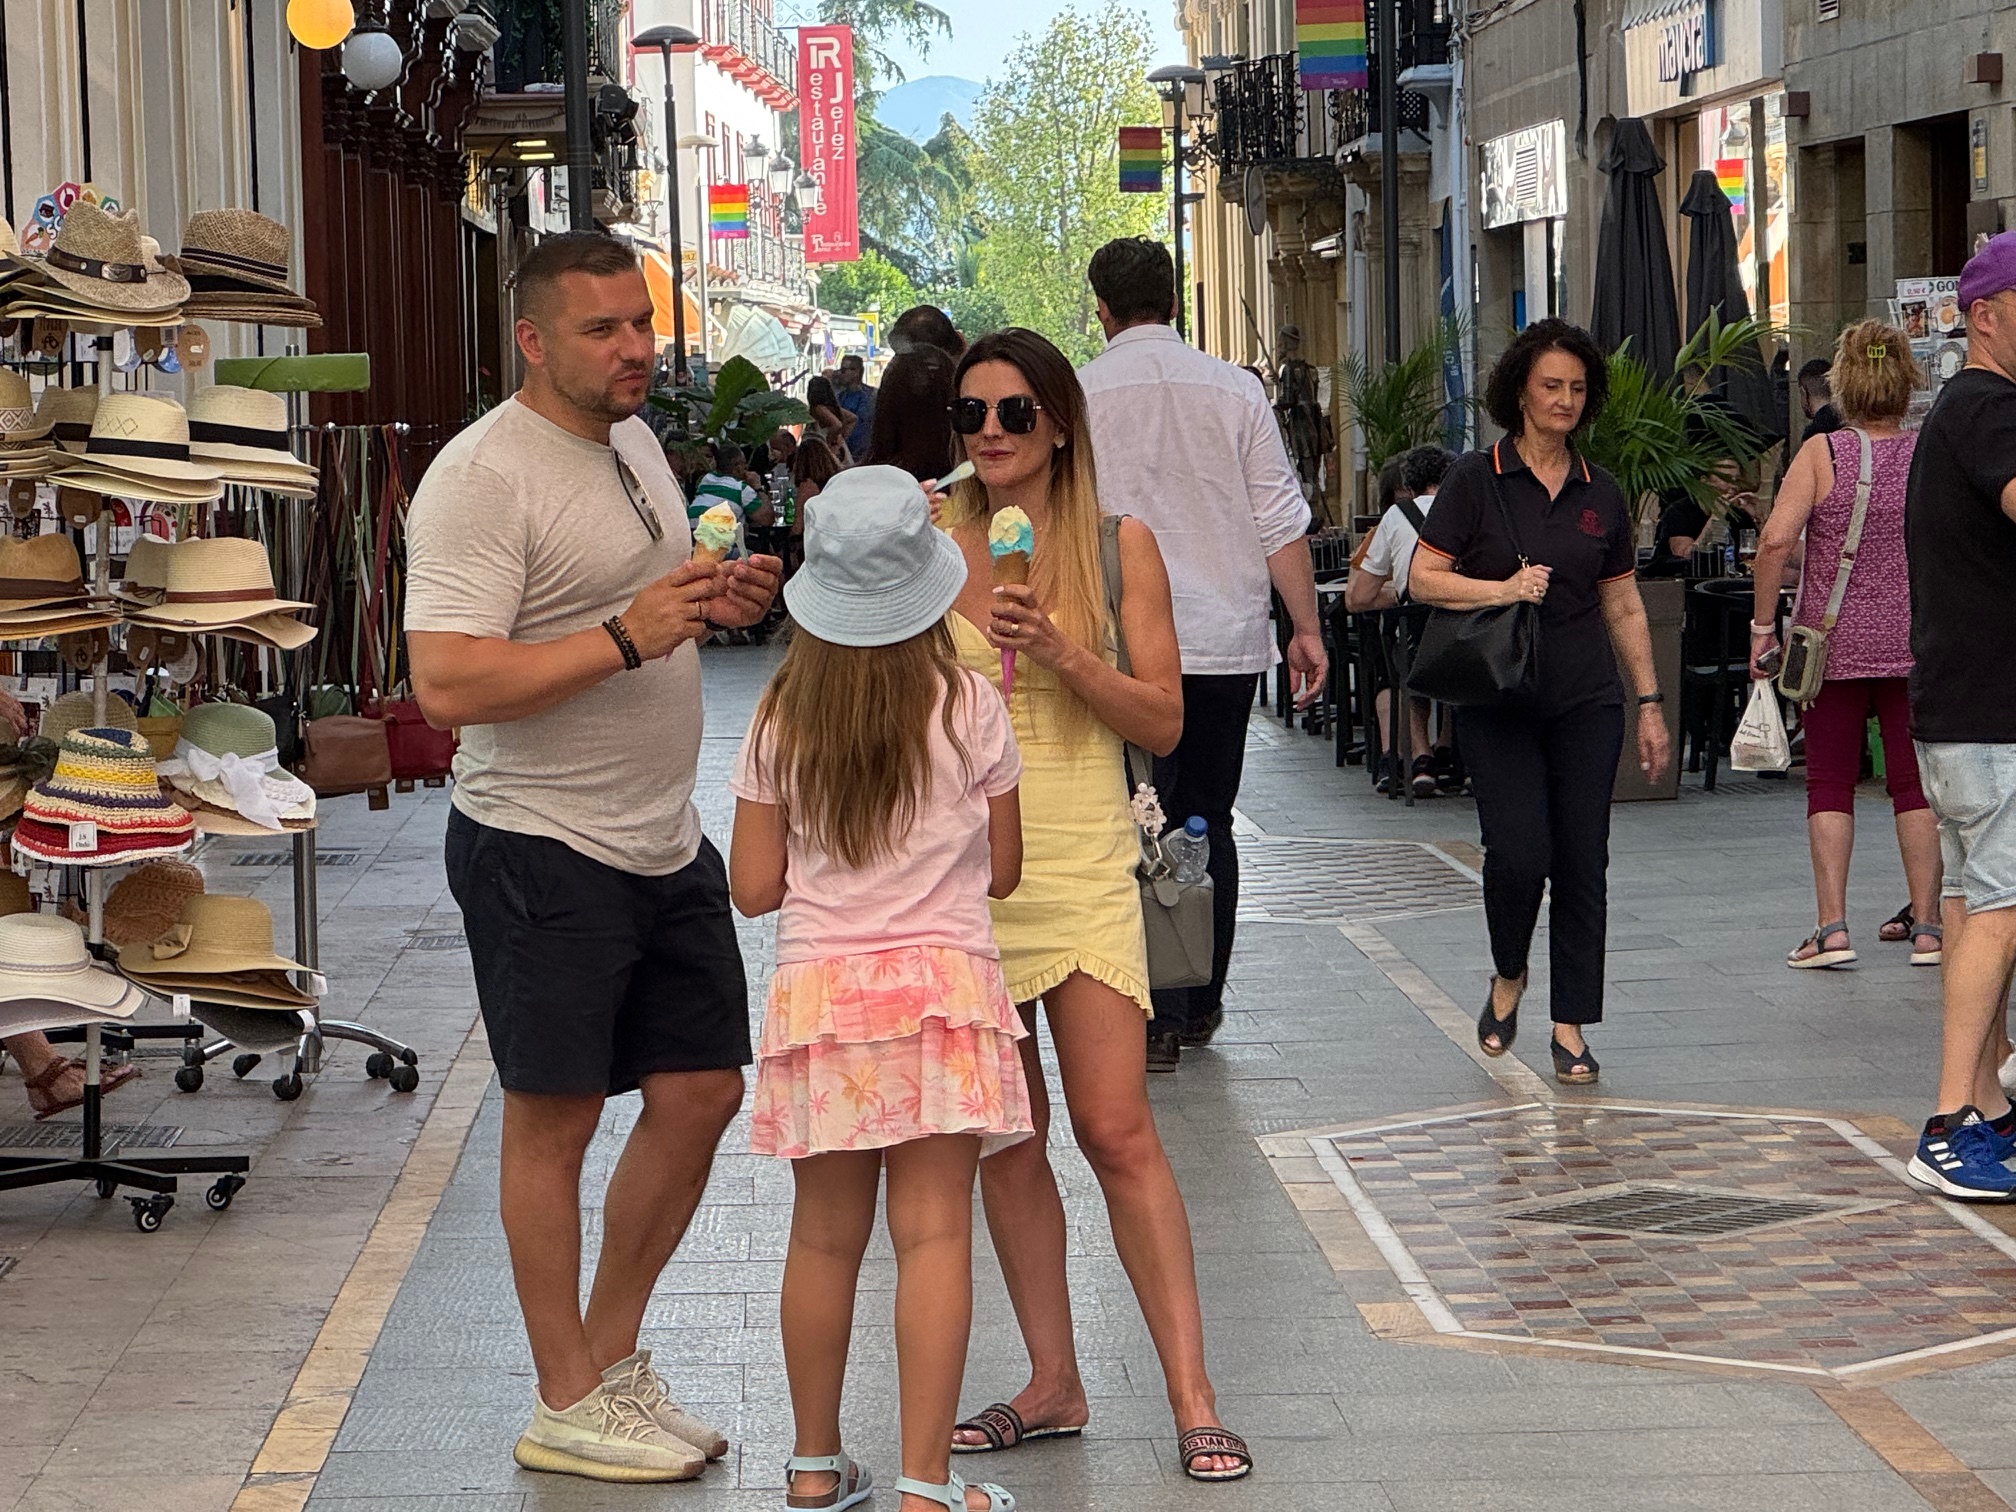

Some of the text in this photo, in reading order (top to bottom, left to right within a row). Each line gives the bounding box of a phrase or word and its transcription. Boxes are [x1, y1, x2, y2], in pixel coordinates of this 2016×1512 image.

[807, 36, 842, 215] Restaurante
[830, 71, 845, 160] Jerez
[987, 1413, 1012, 1435] DIOR
